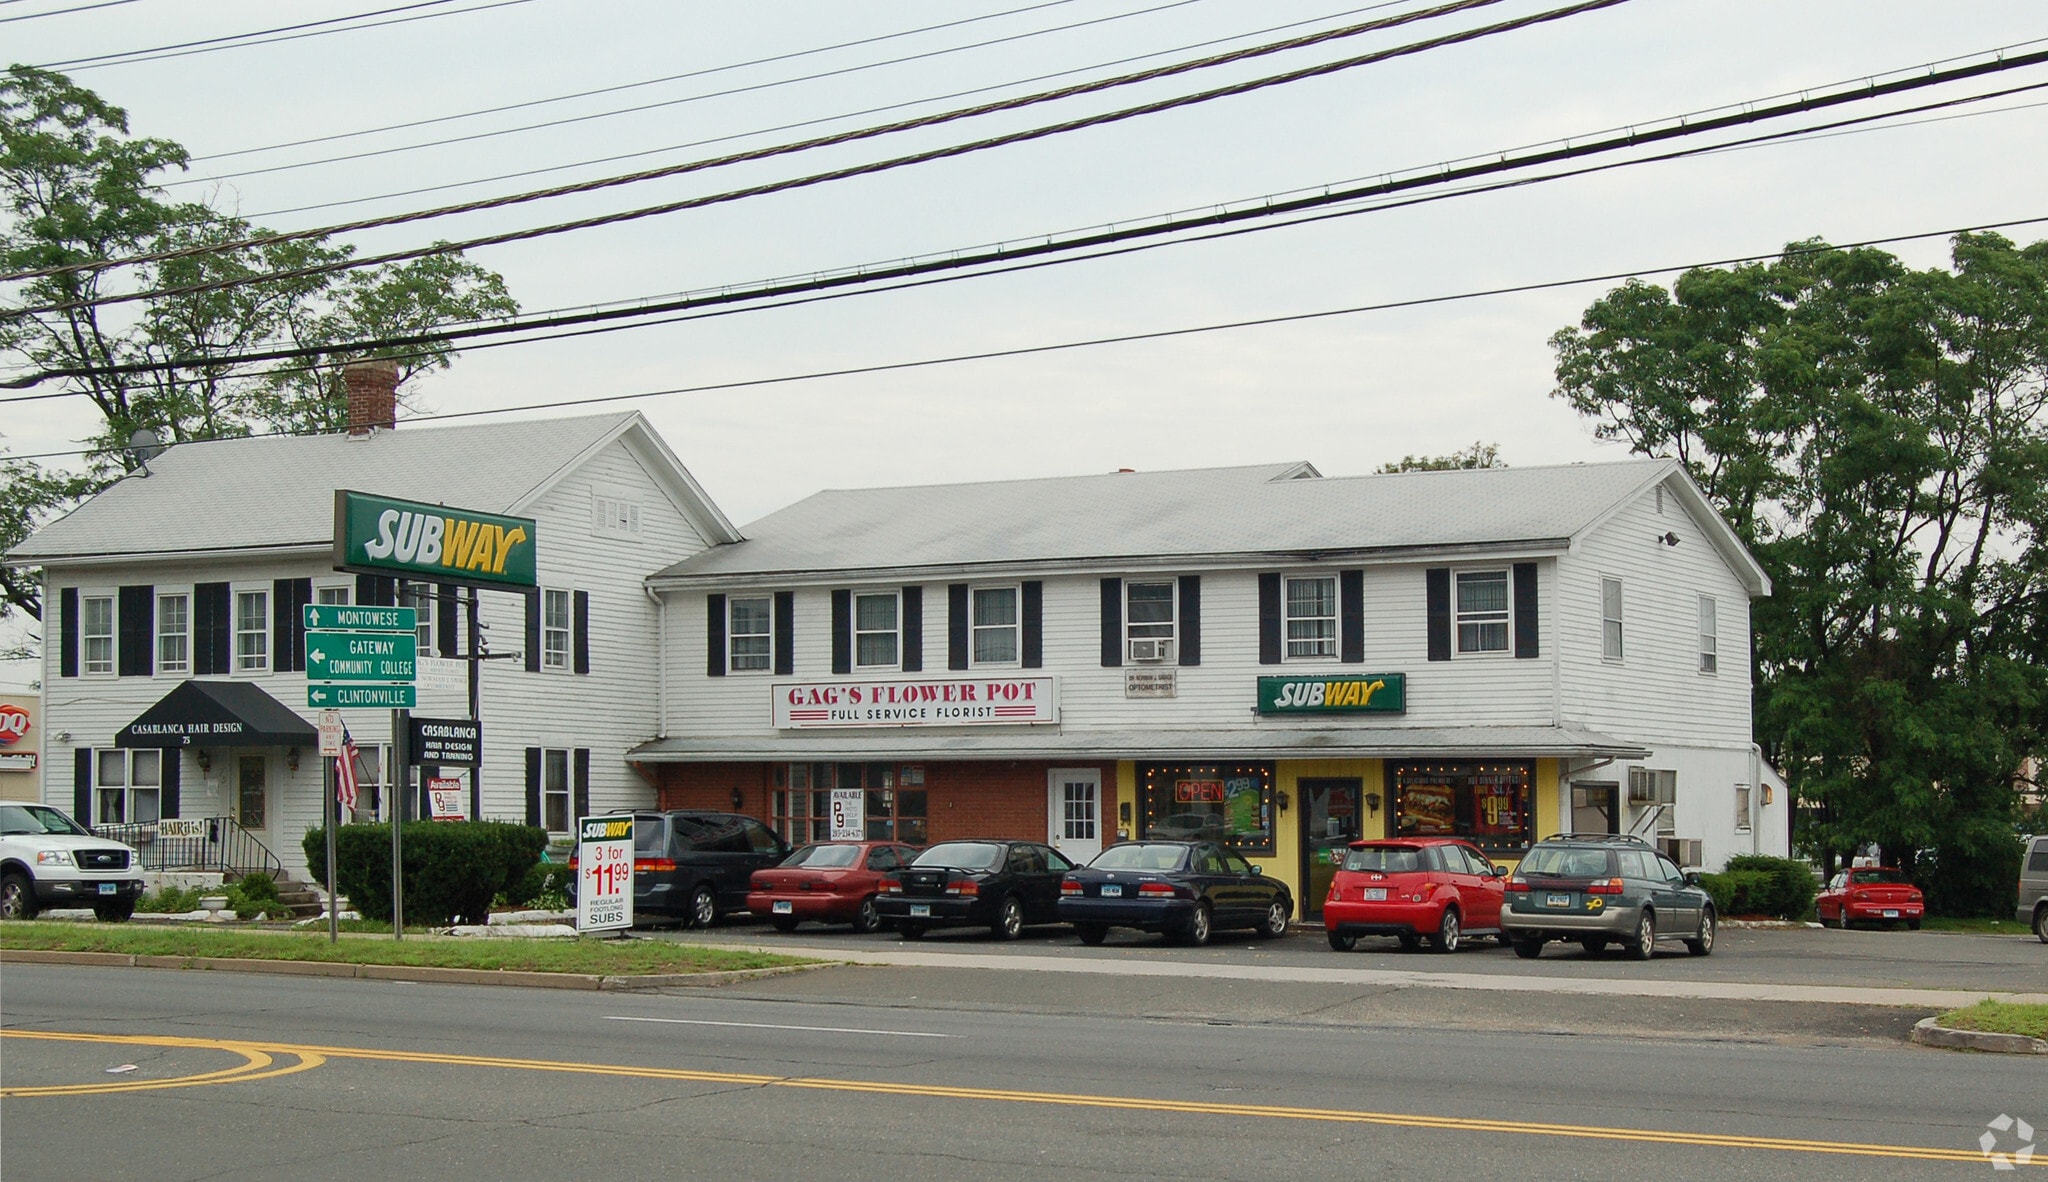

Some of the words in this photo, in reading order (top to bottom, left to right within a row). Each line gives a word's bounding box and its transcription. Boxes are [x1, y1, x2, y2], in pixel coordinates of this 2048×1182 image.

[364, 509, 526, 574] SUBWAY
[337, 610, 399, 626] MONTOWESE
[349, 640, 395, 655] GATEWAY
[329, 660, 372, 674] COMMUNITY
[380, 661, 413, 675] COLLEGE
[788, 685, 862, 706] GAG'S
[872, 682, 977, 705] FLOWER
[987, 682, 1037, 702] POT
[1128, 683, 1173, 691] OPTOMETRIST
[1273, 678, 1385, 709] SUBWAY
[337, 689, 406, 704] CLINTONVILLE
[325, 714, 335, 724] NO
[831, 708, 859, 720] FULL
[867, 707, 926, 720] SERVICE
[936, 706, 992, 718] FLORIST
[131, 723, 184, 735] CASABLANCA
[188, 723, 210, 734] HAIR
[213, 722, 243, 733] DESIGN
[421, 724, 477, 739] CASABLANCA
[182, 736, 191, 745] 75
[425, 741, 443, 750] HAIR
[444, 742, 473, 751] DESIGN
[423, 751, 440, 759] AND
[441, 751, 474, 761] TANNING
[430, 780, 460, 789] Available
[1178, 781, 1222, 801] OPEN
[834, 791, 862, 799] AVAILABLE
[582, 821, 632, 839] SUBWAY
[595, 846, 603, 861] 3
[608, 846, 624, 860] for
[590, 898, 624, 906] REGULAR
[590, 905, 624, 913] FOOTLONG
[590, 912, 624, 925] SUBS
